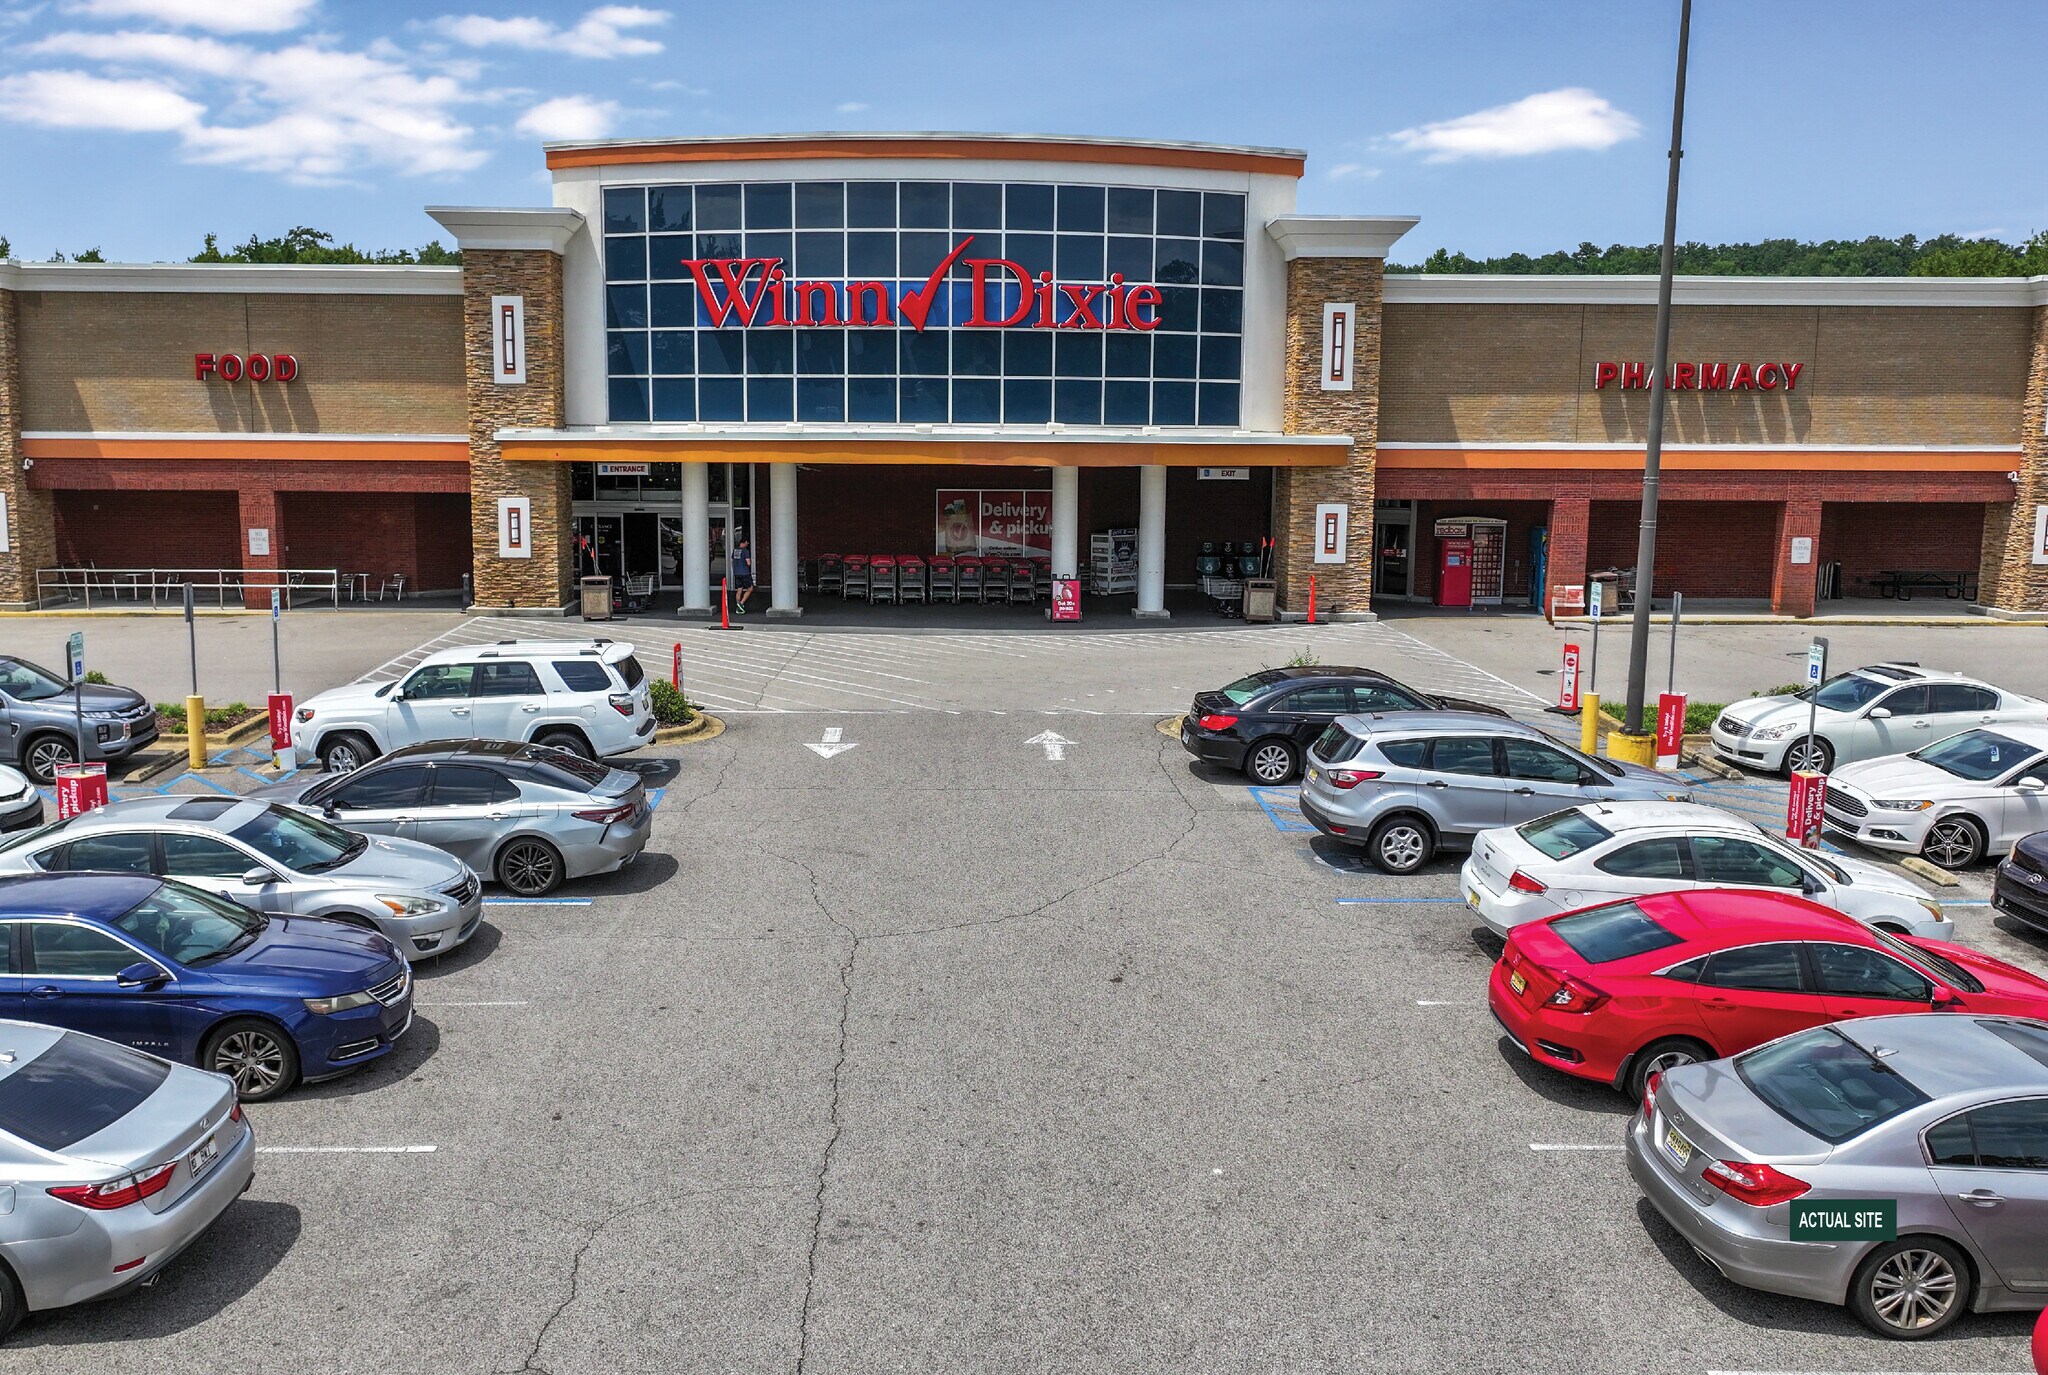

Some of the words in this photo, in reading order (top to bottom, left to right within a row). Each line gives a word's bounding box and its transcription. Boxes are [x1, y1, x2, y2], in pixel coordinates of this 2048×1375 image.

[681, 257, 896, 329] Winn
[963, 258, 1164, 331] Dixie
[195, 353, 299, 382] FOOD
[610, 465, 646, 473] ENTRANCE
[982, 502, 1047, 521] Delivery
[989, 520, 1003, 535] &
[61, 786, 70, 819] elivery
[69, 780, 80, 813] pickup
[1805, 786, 1816, 826] Delivery
[1815, 778, 1825, 810] pickup
[1813, 811, 1820, 820] &
